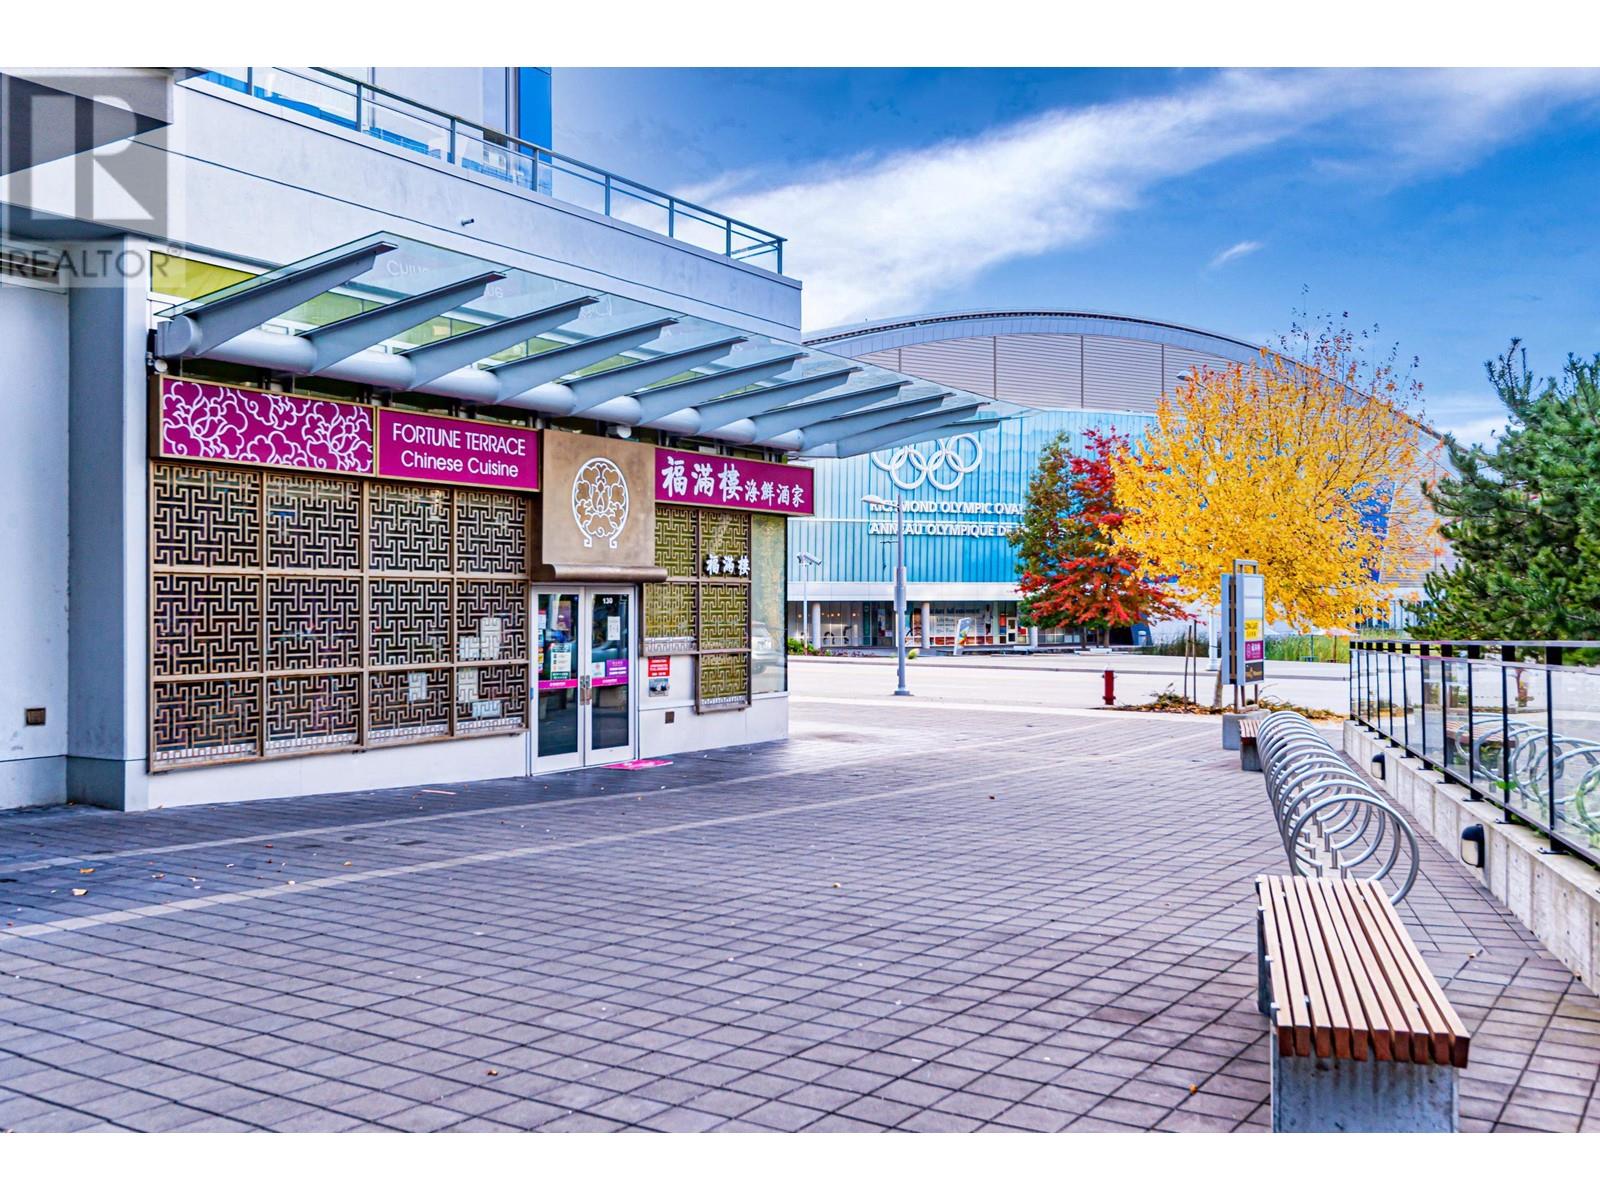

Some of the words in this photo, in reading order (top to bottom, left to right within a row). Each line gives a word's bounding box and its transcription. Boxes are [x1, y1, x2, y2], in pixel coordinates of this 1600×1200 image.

[392, 422, 462, 450] FORTUNE
[465, 431, 526, 457] TERRACE
[401, 450, 464, 475] Chinese
[467, 457, 519, 478] Cuisine
[940, 502, 993, 514] OLYMPIC
[869, 523, 922, 534] ANNAU
[927, 523, 994, 538] OLYMPIQUE
